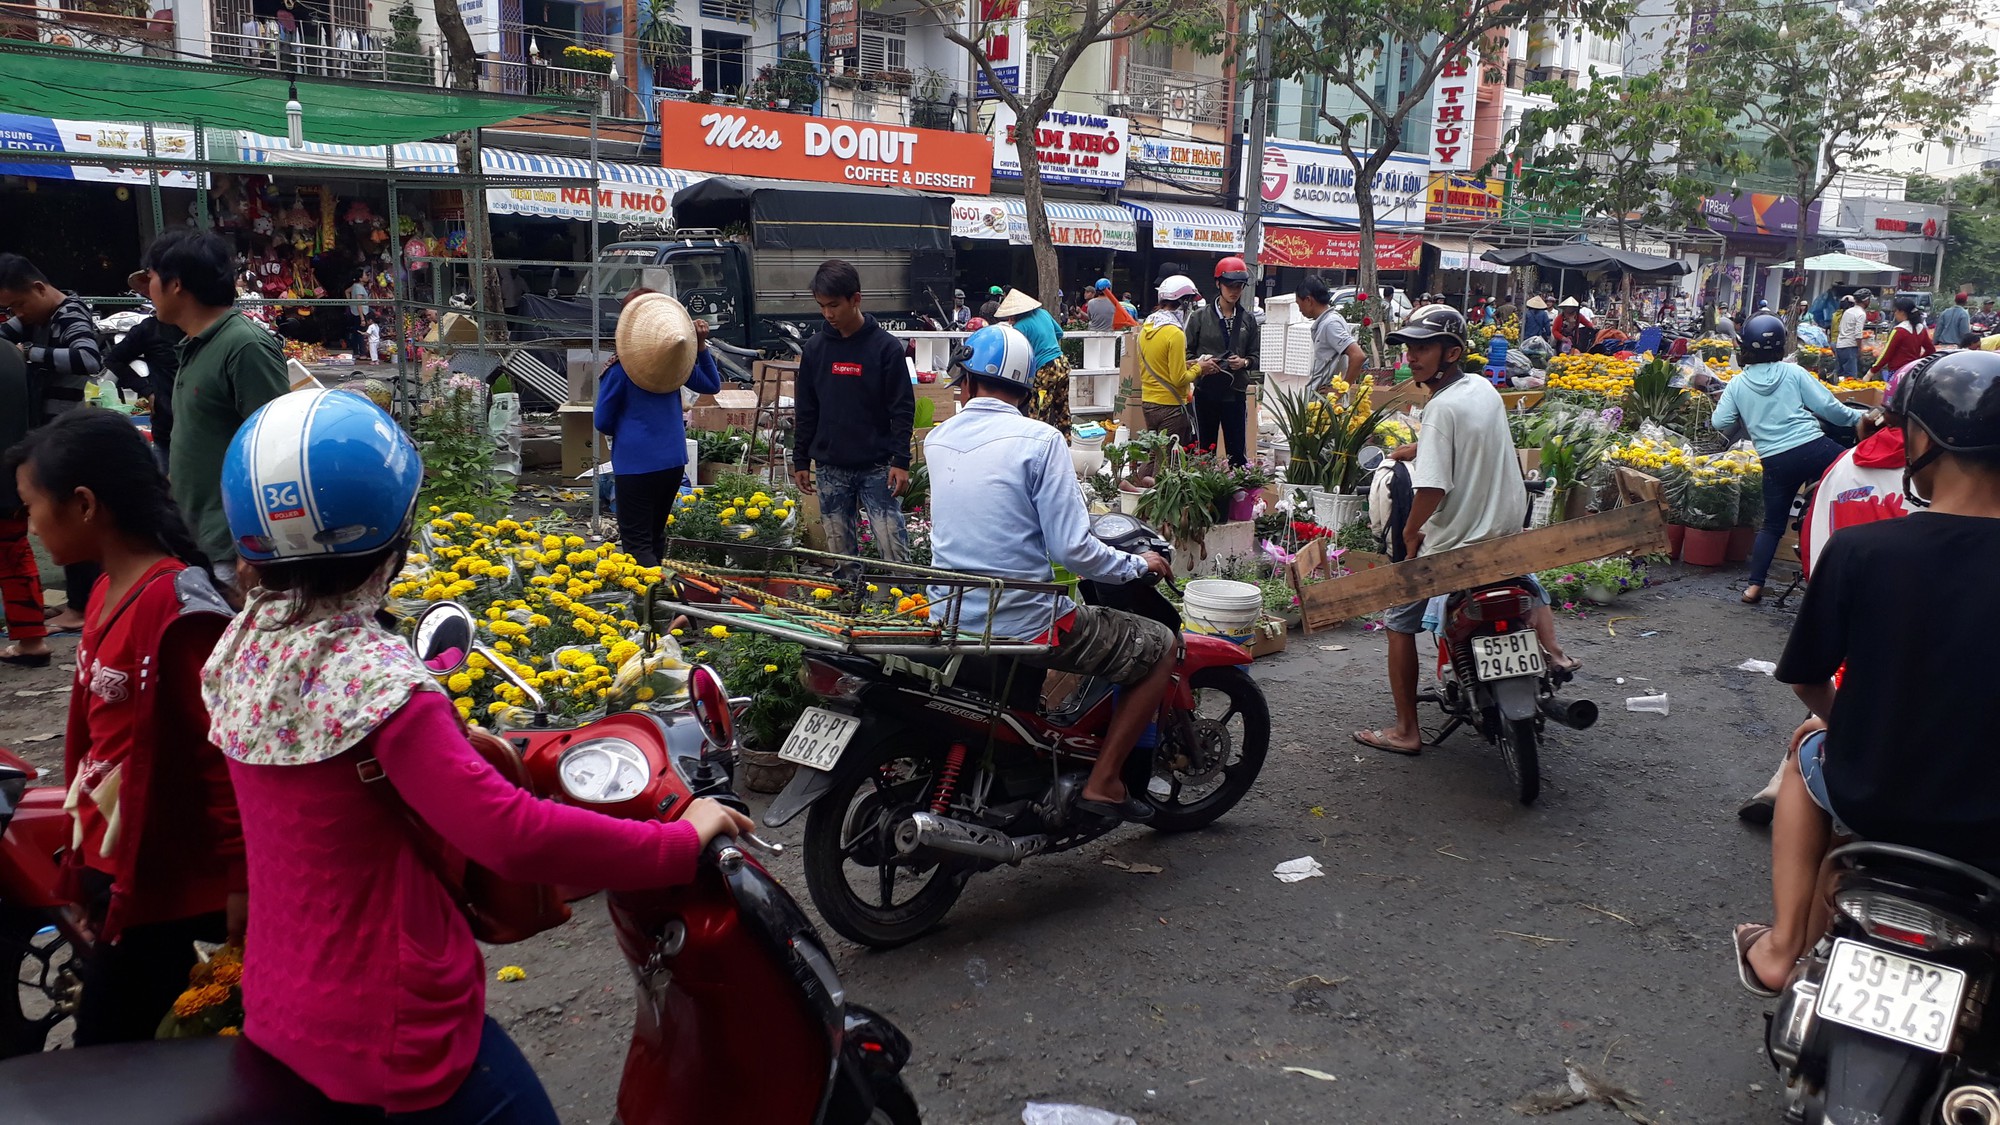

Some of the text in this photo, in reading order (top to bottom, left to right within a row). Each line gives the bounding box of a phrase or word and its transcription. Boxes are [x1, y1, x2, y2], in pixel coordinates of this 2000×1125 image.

[701, 112, 918, 164] Miss DONUT
[1036, 150, 1099, 168] HANH LAN
[1171, 146, 1190, 162] KIM
[1191, 146, 1222, 166] HOÀNG
[844, 165, 976, 189] COFFEE & DESSERT
[1296, 162, 1325, 186] NGÂN
[620, 187, 667, 214] NHỎ
[1293, 187, 1418, 209] SAIGON COMCIAL BANK
[1705, 198, 1730, 214] TPBank
[1049, 221, 1070, 245] ĂM
[1073, 222, 1103, 245] NHỎ
[1103, 229, 1122, 240] THANH
[1194, 229, 1208, 242] KIM
[1210, 228, 1234, 243] HOÀNG
[833, 364, 860, 373] Supreme
[267, 485, 299, 509] 3G
[1480, 653, 1540, 679] 294.60
[784, 734, 840, 767] 098.49
[1827, 982, 1945, 1043] 425.43
